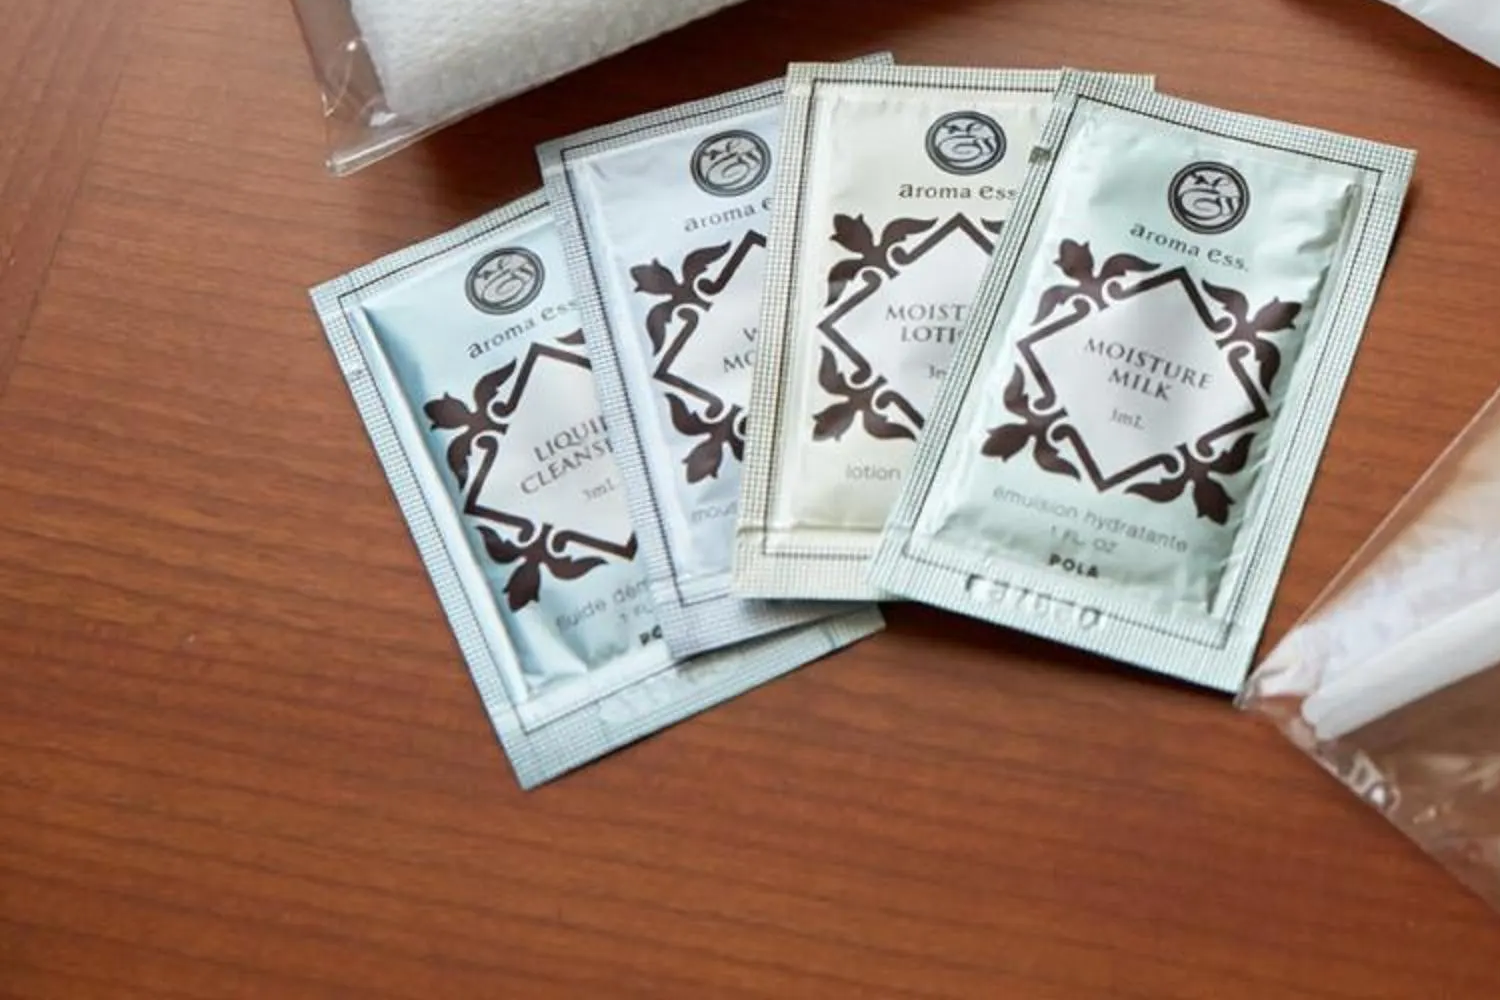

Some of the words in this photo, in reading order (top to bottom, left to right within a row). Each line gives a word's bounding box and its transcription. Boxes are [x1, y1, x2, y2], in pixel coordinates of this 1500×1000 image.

[899, 183, 972, 200] aroma
[684, 203, 756, 233] aroma
[1129, 221, 1201, 258] aroma
[467, 317, 536, 360] aroma
[1084, 338, 1214, 390] MOISTURE
[1108, 367, 1172, 402] MILK
[845, 463, 902, 482] lotion
[1083, 507, 1189, 554] hydratante
[1047, 553, 1100, 579] POLA
